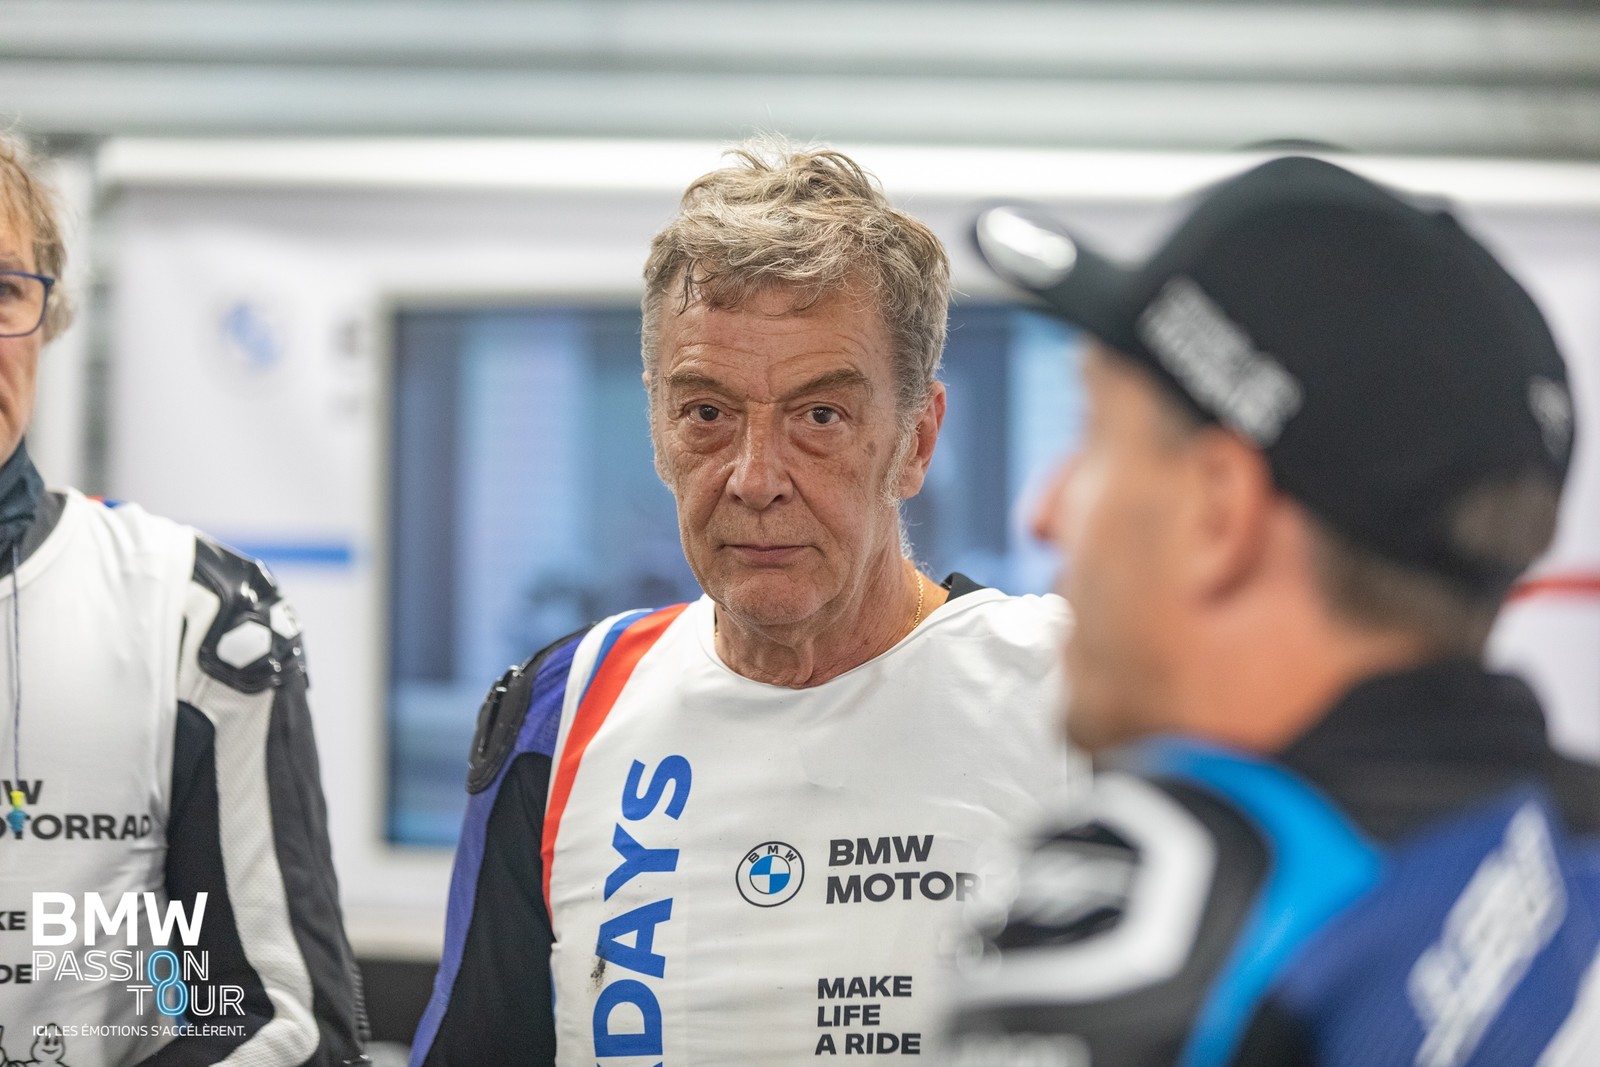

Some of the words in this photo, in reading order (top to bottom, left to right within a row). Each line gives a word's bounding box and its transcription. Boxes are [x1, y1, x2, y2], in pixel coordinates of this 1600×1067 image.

[0, 780, 43, 805] W
[747, 844, 798, 864] BMW
[828, 834, 934, 867] BMW
[826, 871, 985, 905] MOTOR
[592, 755, 692, 1067] DAYS
[817, 975, 912, 999] MAKE
[817, 1004, 880, 1027] LIFE
[815, 1034, 836, 1055] A
[845, 1033, 921, 1055] RIDE
